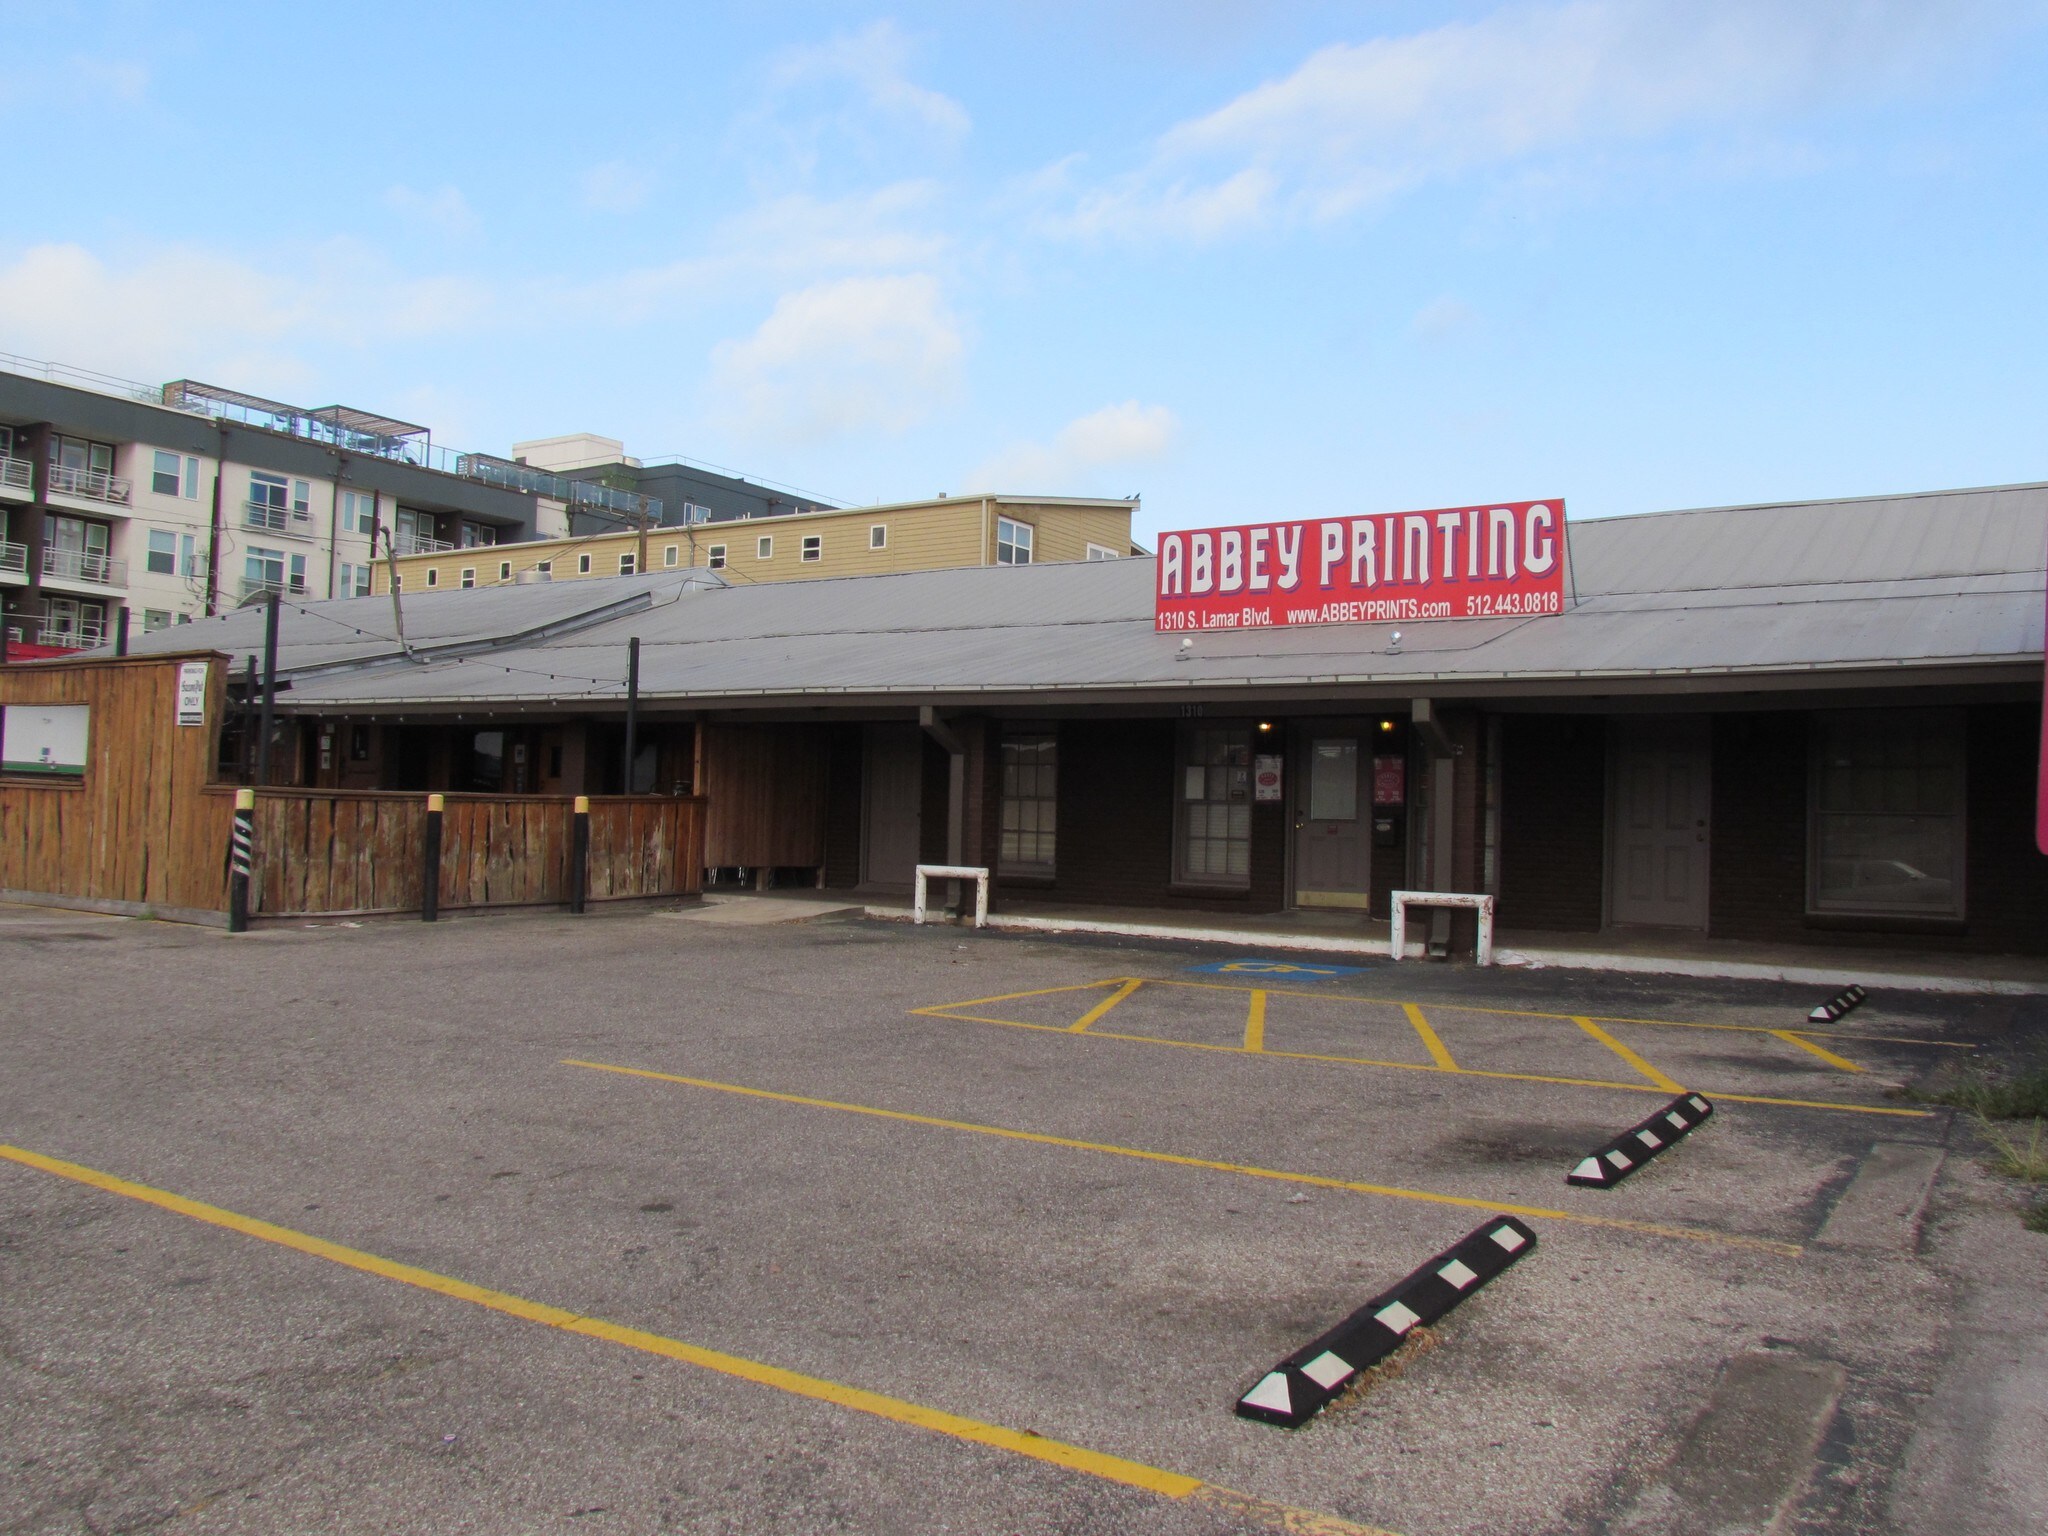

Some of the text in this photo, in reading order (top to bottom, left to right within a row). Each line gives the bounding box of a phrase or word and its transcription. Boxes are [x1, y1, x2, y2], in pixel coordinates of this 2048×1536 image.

[1161, 504, 1554, 595] ABBEY PRINTING
[1287, 599, 1451, 623] www.ABBEYPRINTS.com
[1466, 592, 1558, 615] 512.443.0818
[1159, 607, 1273, 629] 1310 S. Lamar Blvd.
[1181, 704, 1203, 717] 1310
